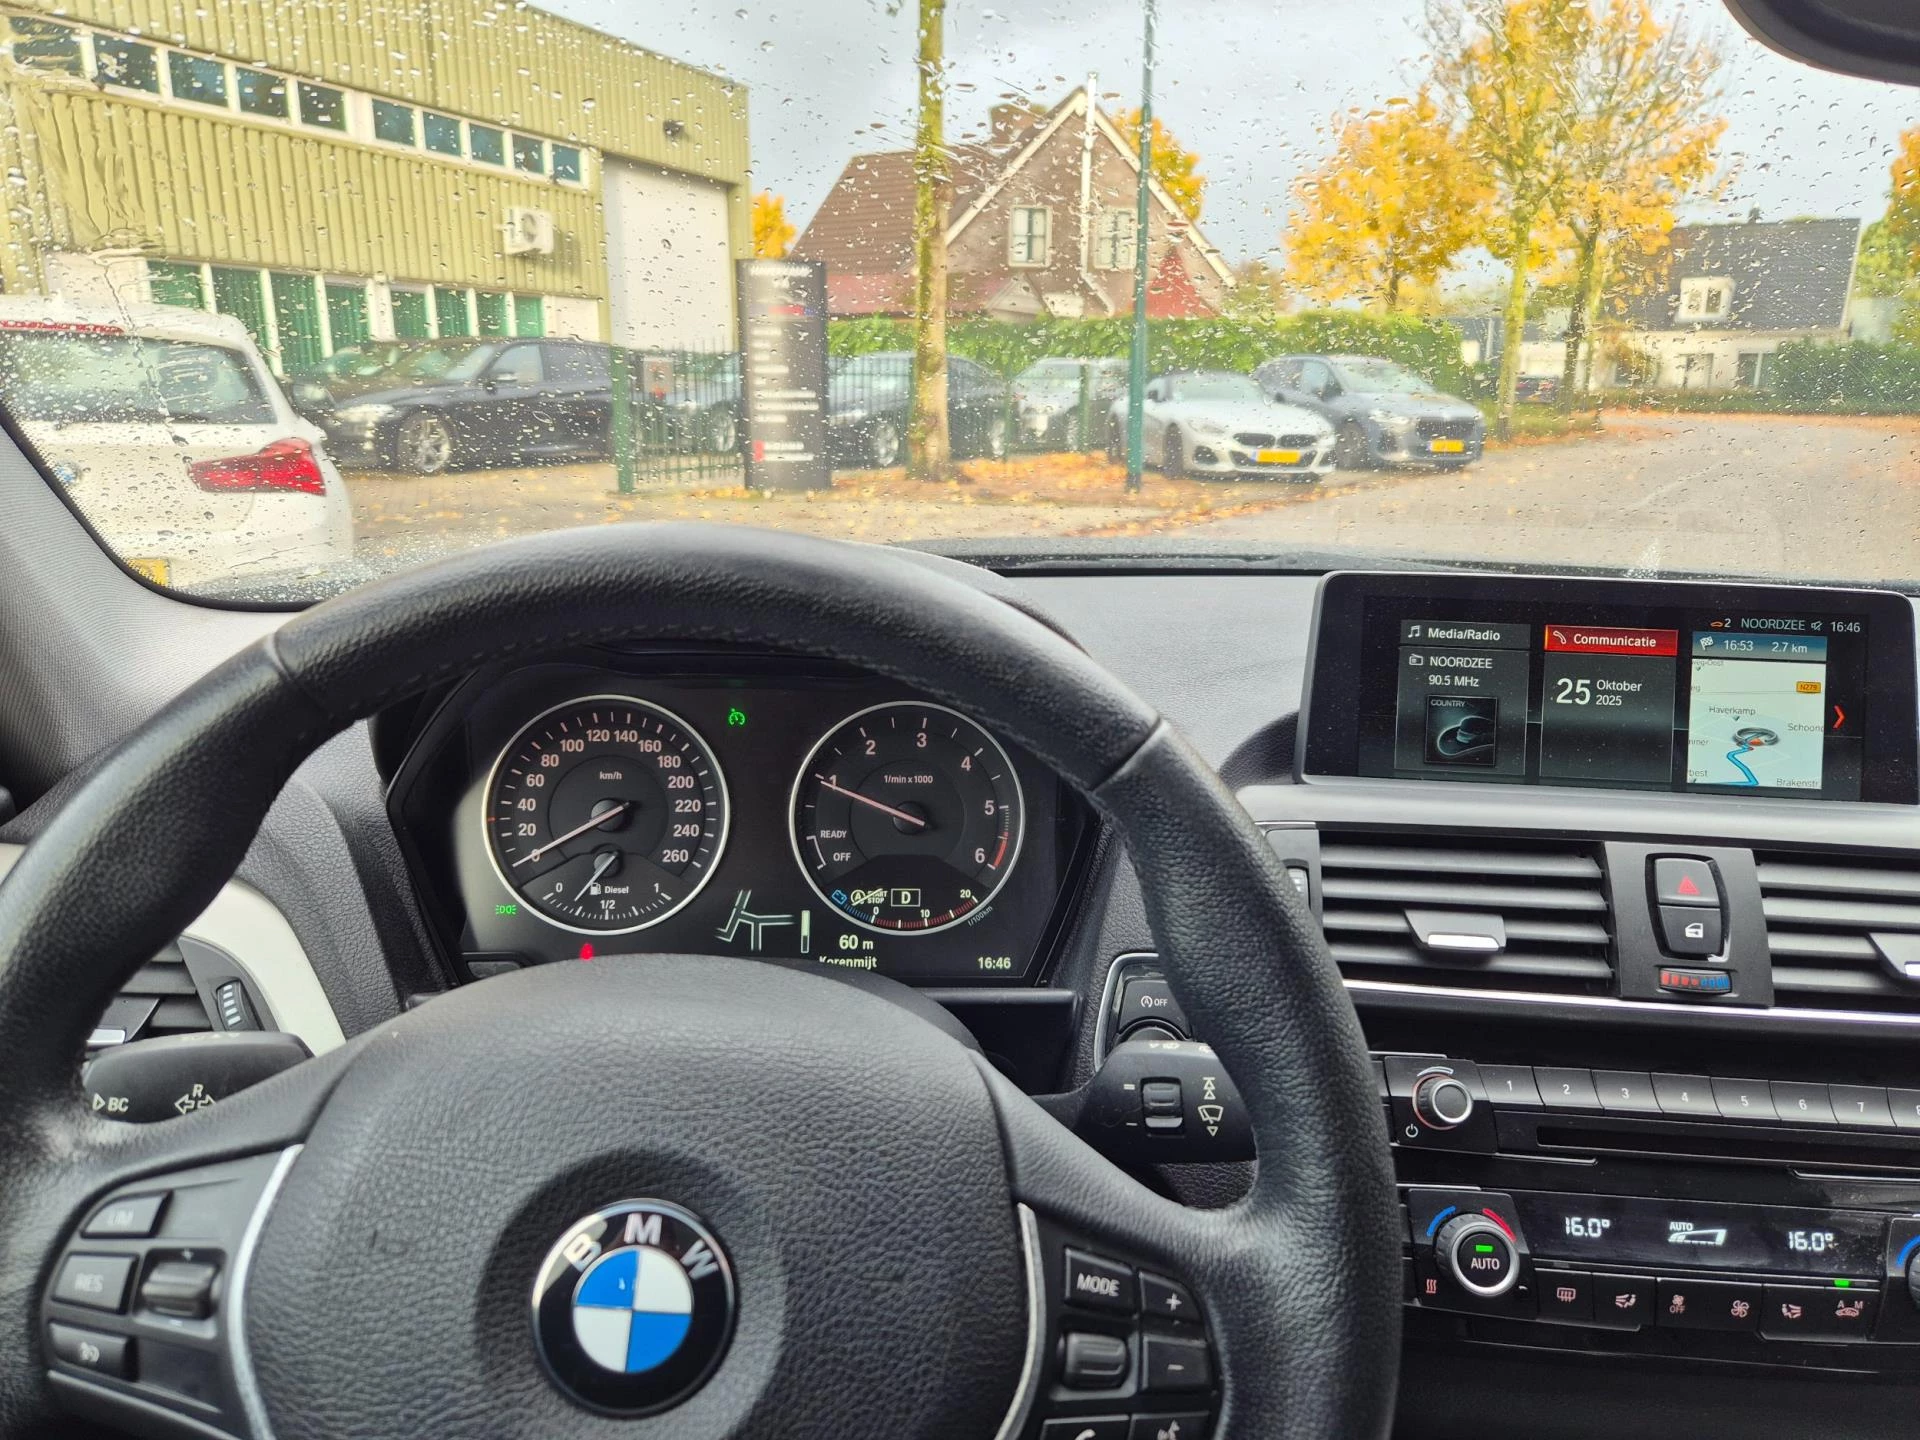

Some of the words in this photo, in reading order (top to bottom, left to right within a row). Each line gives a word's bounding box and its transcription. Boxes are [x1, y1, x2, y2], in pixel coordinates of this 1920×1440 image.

[1724, 618, 1731, 628] 2
[1741, 618, 1805, 631] NOORDZEE
[1831, 621, 1860, 633] 16:46
[1428, 628, 1500, 641] Media/Radio
[1573, 633, 1656, 647] Communicatie
[1724, 640, 1753, 651] 16:53
[1772, 641, 1789, 653] 2.7
[1792, 644, 1808, 654] km
[1430, 656, 1492, 669] NOORDZEE
[1428, 674, 1451, 686] 90.5
[1454, 675, 1479, 687] MHz
[1596, 680, 1642, 692] Oktober
[1556, 678, 1591, 705] 25
[1430, 699, 1466, 708] COUNTRY
[1595, 695, 1622, 706] 2025
[1708, 706, 1756, 716] Haverkamp
[586, 729, 610, 742] 120
[613, 730, 638, 743] 140
[916, 732, 927, 748] 3
[560, 739, 584, 752] 100
[638, 740, 662, 753] 160
[865, 739, 876, 755] 2
[540, 754, 560, 767] 80
[657, 755, 681, 768] 180
[961, 756, 972, 771] 4
[526, 774, 545, 787] 60
[599, 771, 622, 781] km/h
[668, 776, 694, 789] 200
[829, 774, 837, 790] 1
[884, 774, 906, 784] 1/min
[913, 774, 933, 784] 1000
[517, 798, 536, 811] 40
[675, 799, 701, 813] 220
[984, 800, 995, 815] 5
[518, 823, 536, 836] 20
[673, 824, 699, 837] 240
[820, 829, 847, 839] READY
[531, 848, 540, 862] 0
[662, 850, 689, 863] 260
[833, 852, 851, 862] OFF
[974, 848, 985, 863] 6
[555, 882, 563, 893] 0
[604, 886, 629, 894] Diesel
[653, 883, 659, 893] 1
[960, 889, 971, 898] 20
[600, 900, 616, 909] 1/2
[901, 891, 911, 905] D
[873, 906, 879, 915] 0
[920, 909, 930, 918] 10
[839, 934, 859, 950] 60
[862, 940, 874, 950] m
[978, 956, 1011, 969] 16:46
[1154, 998, 1168, 1006] OFF
[192, 1084, 204, 1097] R
[1506, 1080, 1513, 1092] 1
[1562, 1084, 1571, 1095] 2
[1621, 1088, 1630, 1099] 3
[1681, 1092, 1689, 1102] 4
[107, 1097, 129, 1112] BC
[1740, 1095, 1749, 1107] 5
[1798, 1099, 1807, 1110] 6
[1856, 1102, 1865, 1113] 7
[1669, 1221, 1694, 1232] AUTO
[563, 1212, 719, 1280] BMW
[1471, 1257, 1500, 1271] AUTO
[1077, 1273, 1120, 1297] MODE
[1669, 1304, 1686, 1314] OFF
